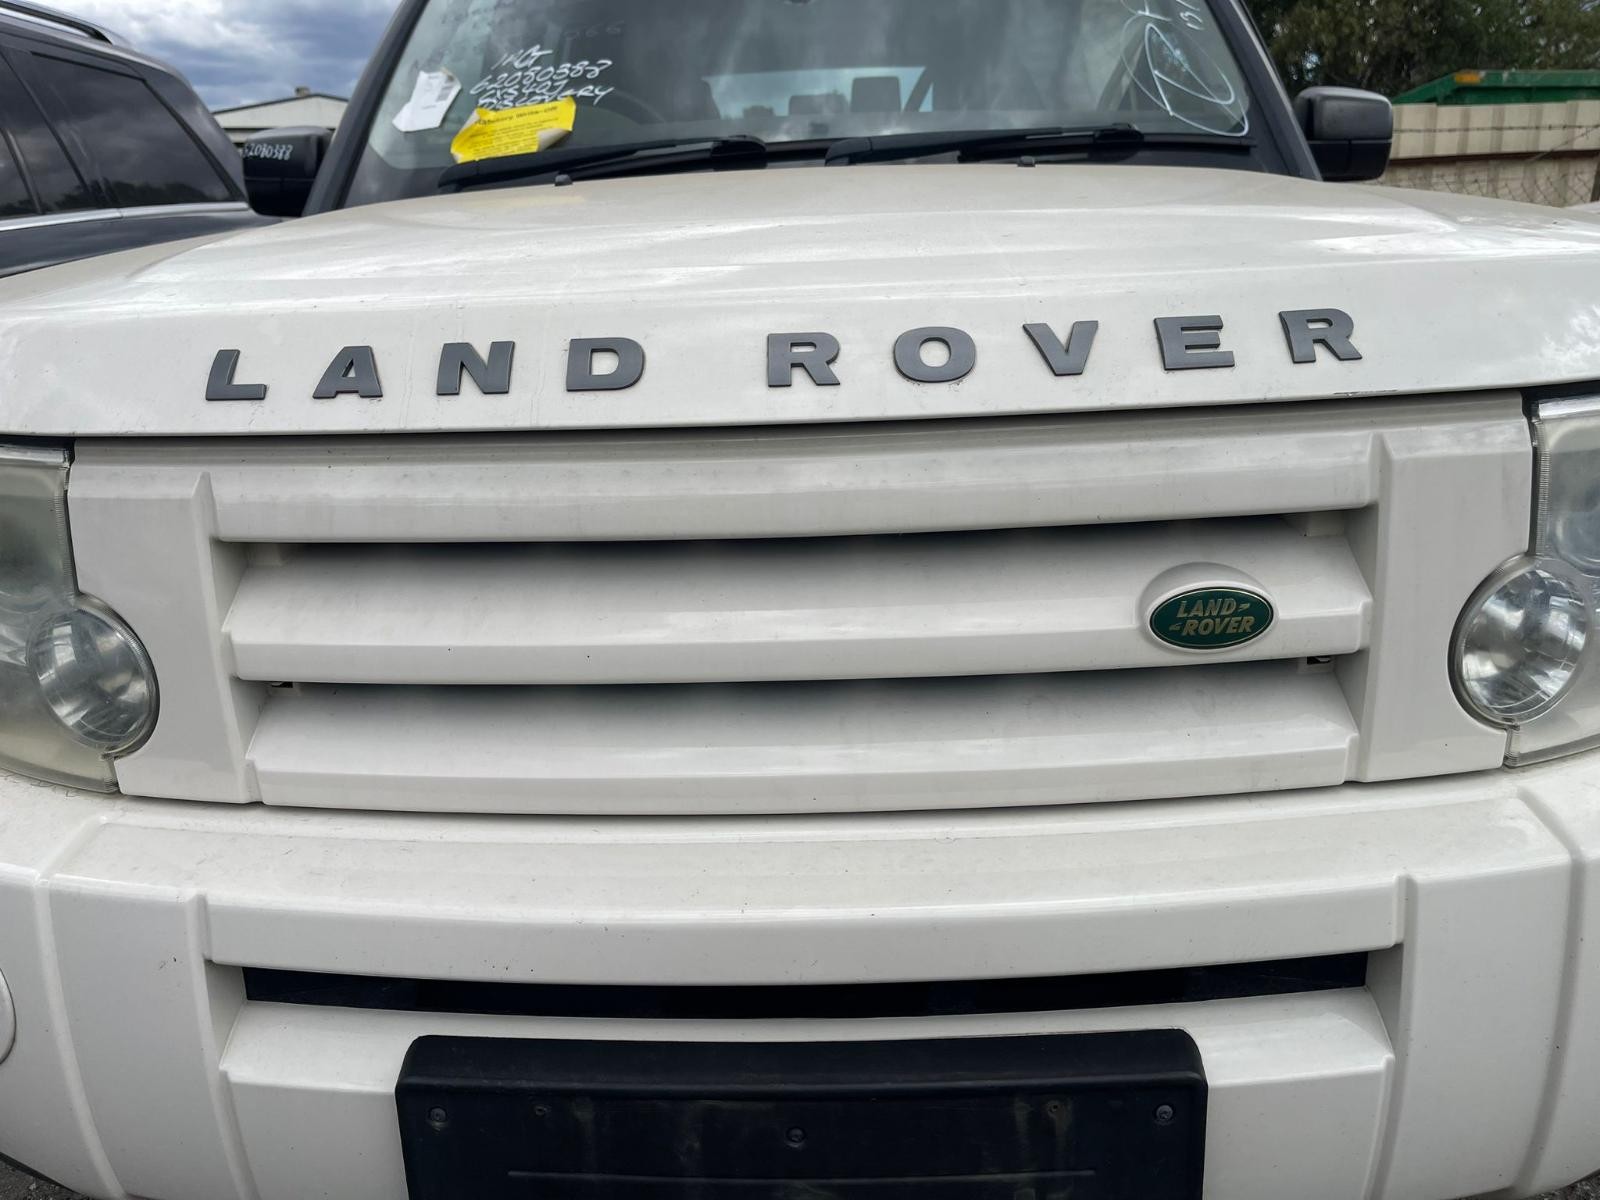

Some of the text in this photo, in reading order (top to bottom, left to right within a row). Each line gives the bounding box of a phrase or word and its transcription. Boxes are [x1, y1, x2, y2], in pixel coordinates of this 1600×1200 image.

[205, 307, 1364, 402] LAND ROVER
[1175, 598, 1237, 618] LAND
[1181, 616, 1256, 636] ROVER
